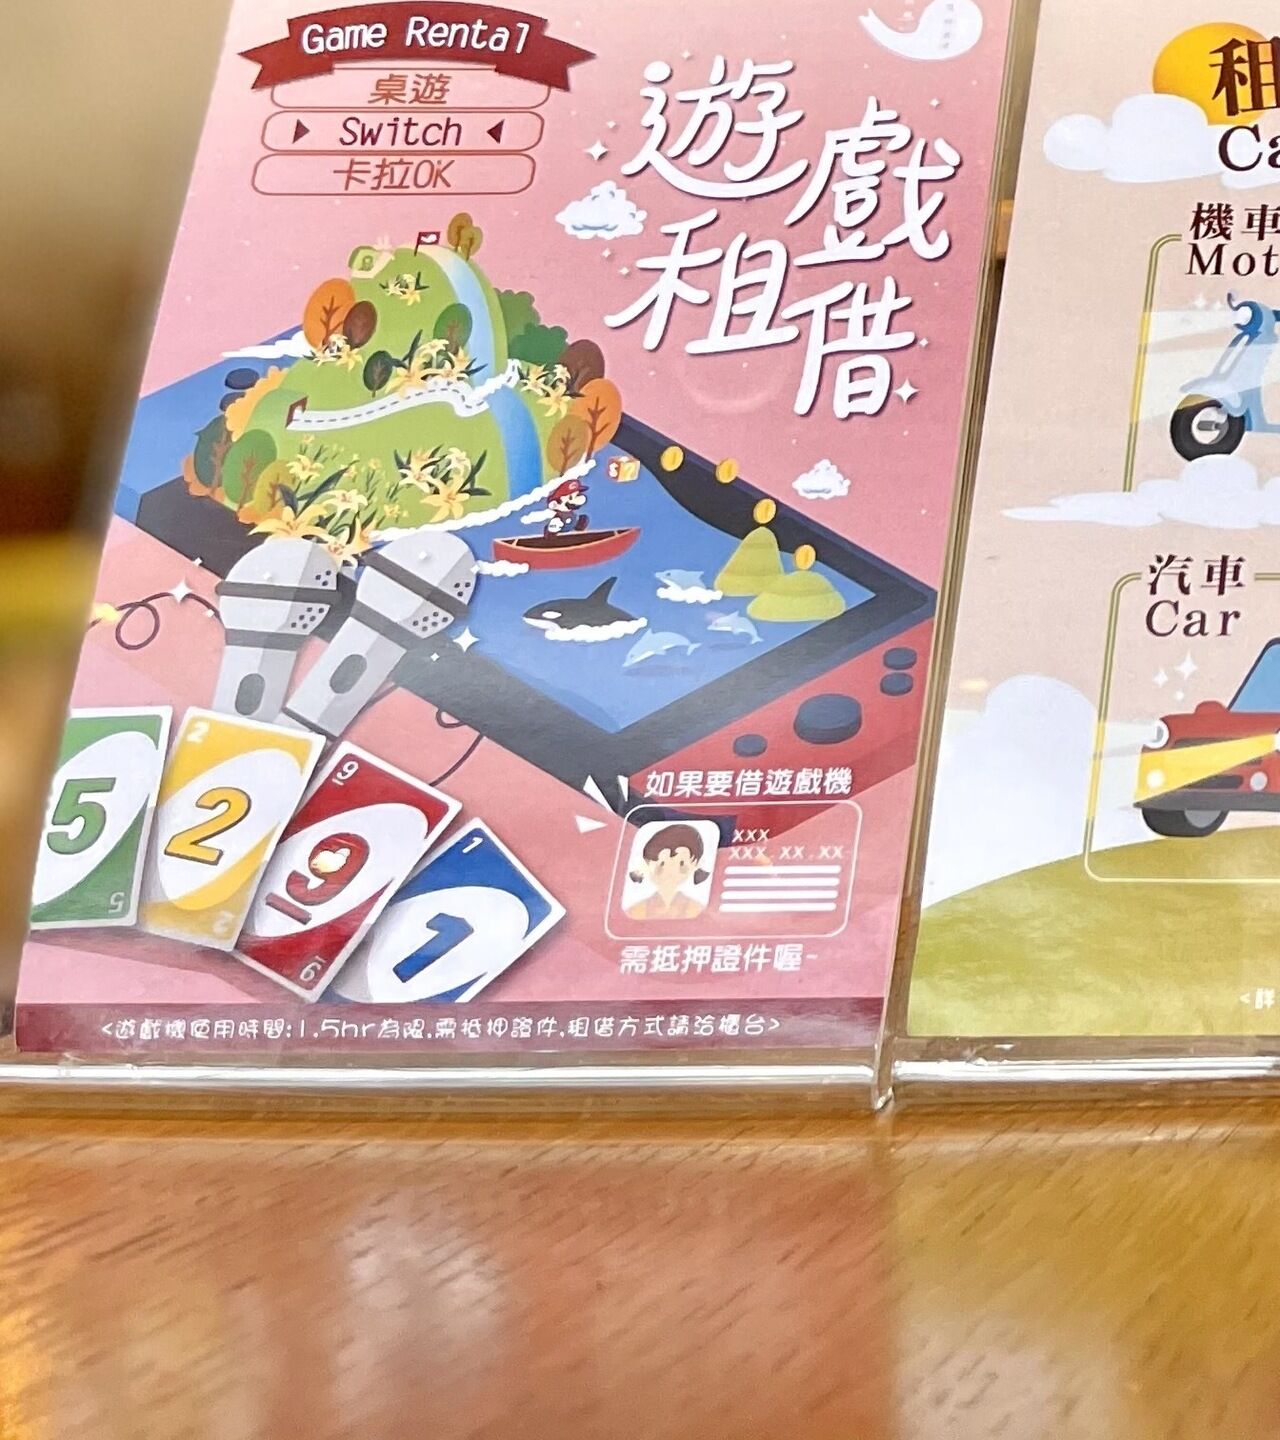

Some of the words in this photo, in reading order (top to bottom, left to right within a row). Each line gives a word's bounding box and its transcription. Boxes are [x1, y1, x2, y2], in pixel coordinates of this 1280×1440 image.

[303, 23, 388, 54] Game
[406, 16, 530, 54] Rental
[368, 73, 452, 105] 桌遊
[339, 117, 463, 146] Switch
[333, 158, 456, 191] 卡拉OK
[620, 55, 962, 266] 遊戲
[604, 208, 917, 419] 租借
[1147, 554, 1247, 596] 汽車
[1145, 599, 1242, 638] Car
[643, 767, 854, 798] 如果要借遊戲機
[47, 777, 117, 855] 5
[164, 786, 253, 867] 2
[392, 913, 475, 984] 1
